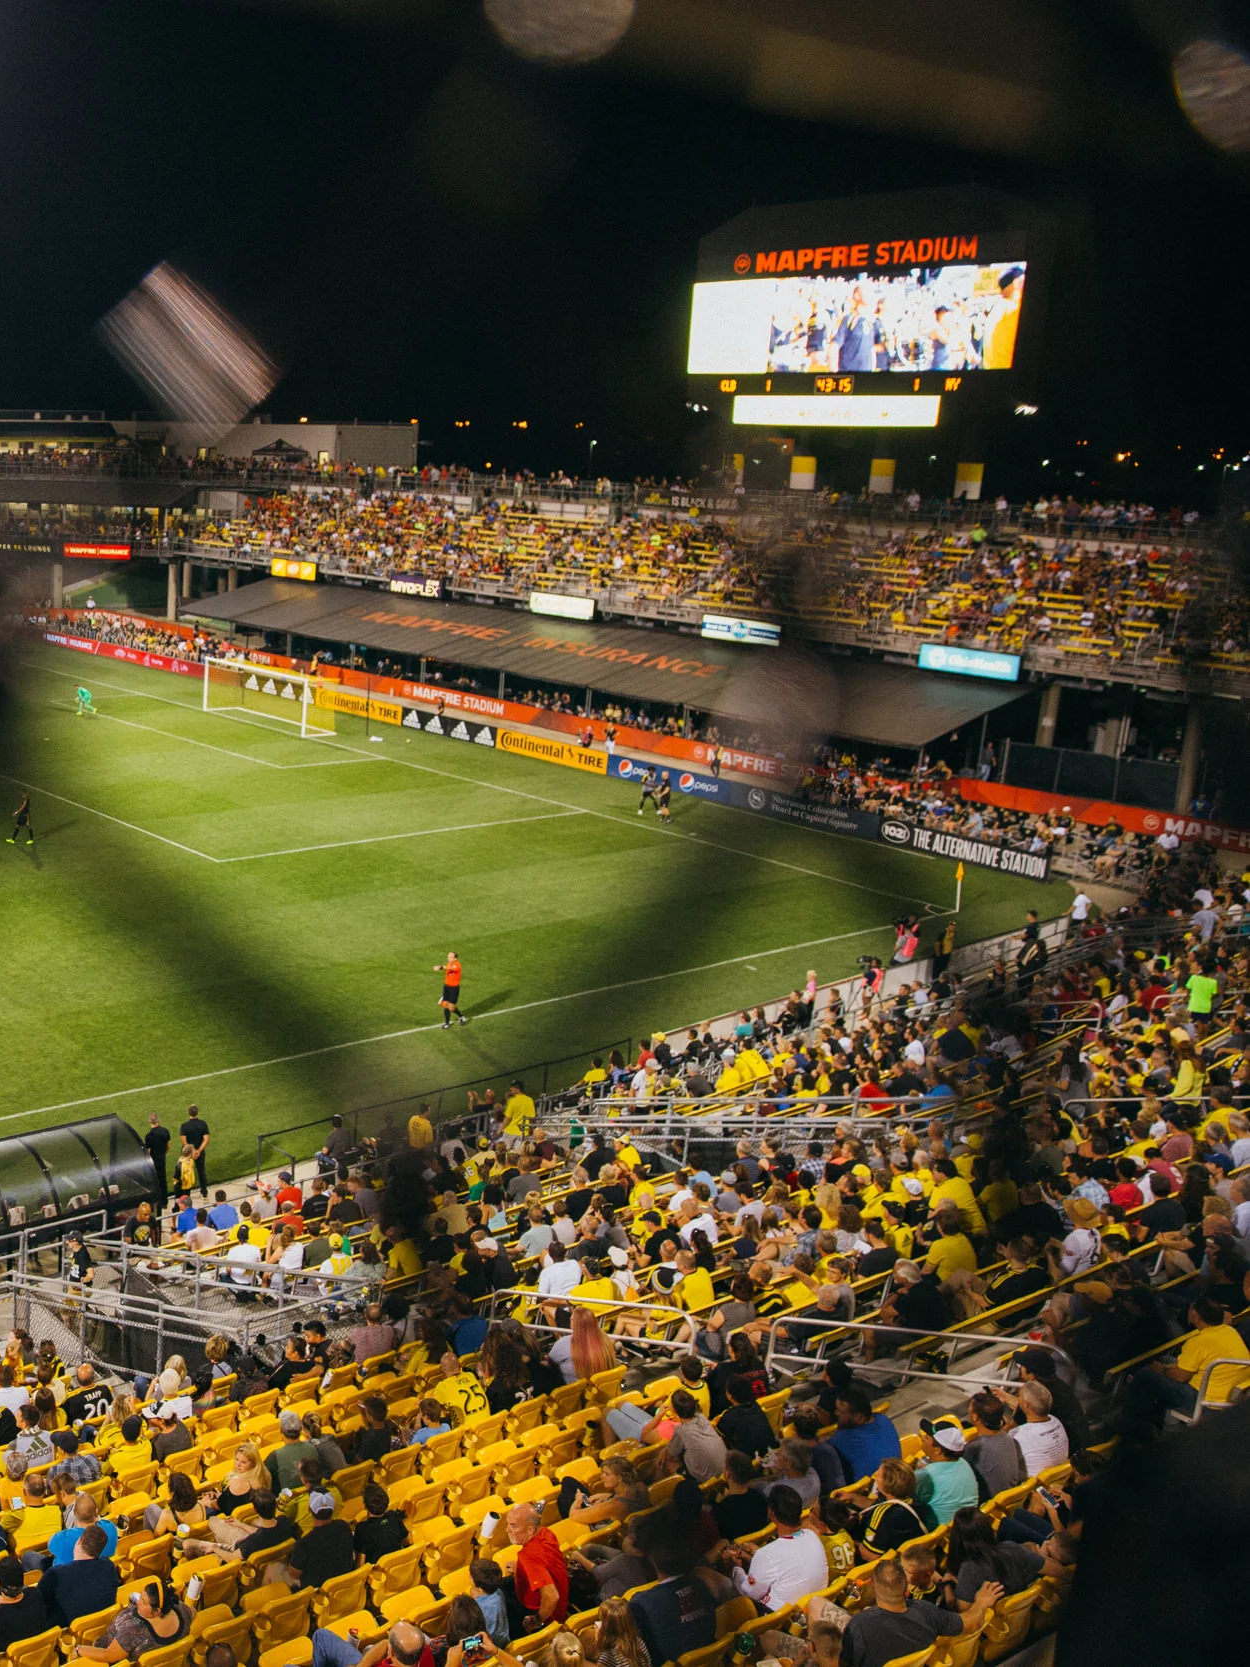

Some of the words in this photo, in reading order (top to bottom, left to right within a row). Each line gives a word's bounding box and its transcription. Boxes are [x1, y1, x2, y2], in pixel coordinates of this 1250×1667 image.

[755, 244, 869, 273] MAPFRE
[874, 236, 978, 265] STADIUM
[816, 377, 852, 393] 43:15
[671, 496, 679, 507] IS
[681, 496, 706, 509] BLACK
[23, 544, 51, 553] LOUNGE
[70, 547, 96, 555] MAPFRE
[99, 548, 129, 556] INSURANCE
[390, 580, 439, 598] MYOPLEX
[46, 632, 68, 645] MAPFRE
[69, 638, 93, 651] INSURANCE
[361, 611, 511, 641] MAPFRE
[523, 636, 729, 679] INSURANCE
[948, 654, 1012, 673] OhioHealth
[412, 685, 461, 707] MAPFRE
[464, 695, 505, 715] STADIUM
[378, 707, 399, 720] TIRE
[500, 731, 566, 759] Continental
[577, 753, 604, 768] TIRE
[706, 747, 777, 774] MAPFRE
[694, 781, 719, 793] pepsi
[773, 794, 806, 810] Sheraton
[806, 803, 849, 818] Columbus
[771, 804, 792, 815] Hotel
[792, 808, 800, 817] at
[800, 811, 828, 825] Capitol
[828, 818, 859, 831] Square
[913, 828, 932, 850] THE
[932, 833, 999, 867] ALTERNATIVE
[1000, 849, 1047, 879] STATION
[84, 1390, 102, 1402] TRAPP
[458, 1383, 487, 1416] 25
[84, 1398, 109, 1420] 20
[25, 1446, 53, 1462] adidas
